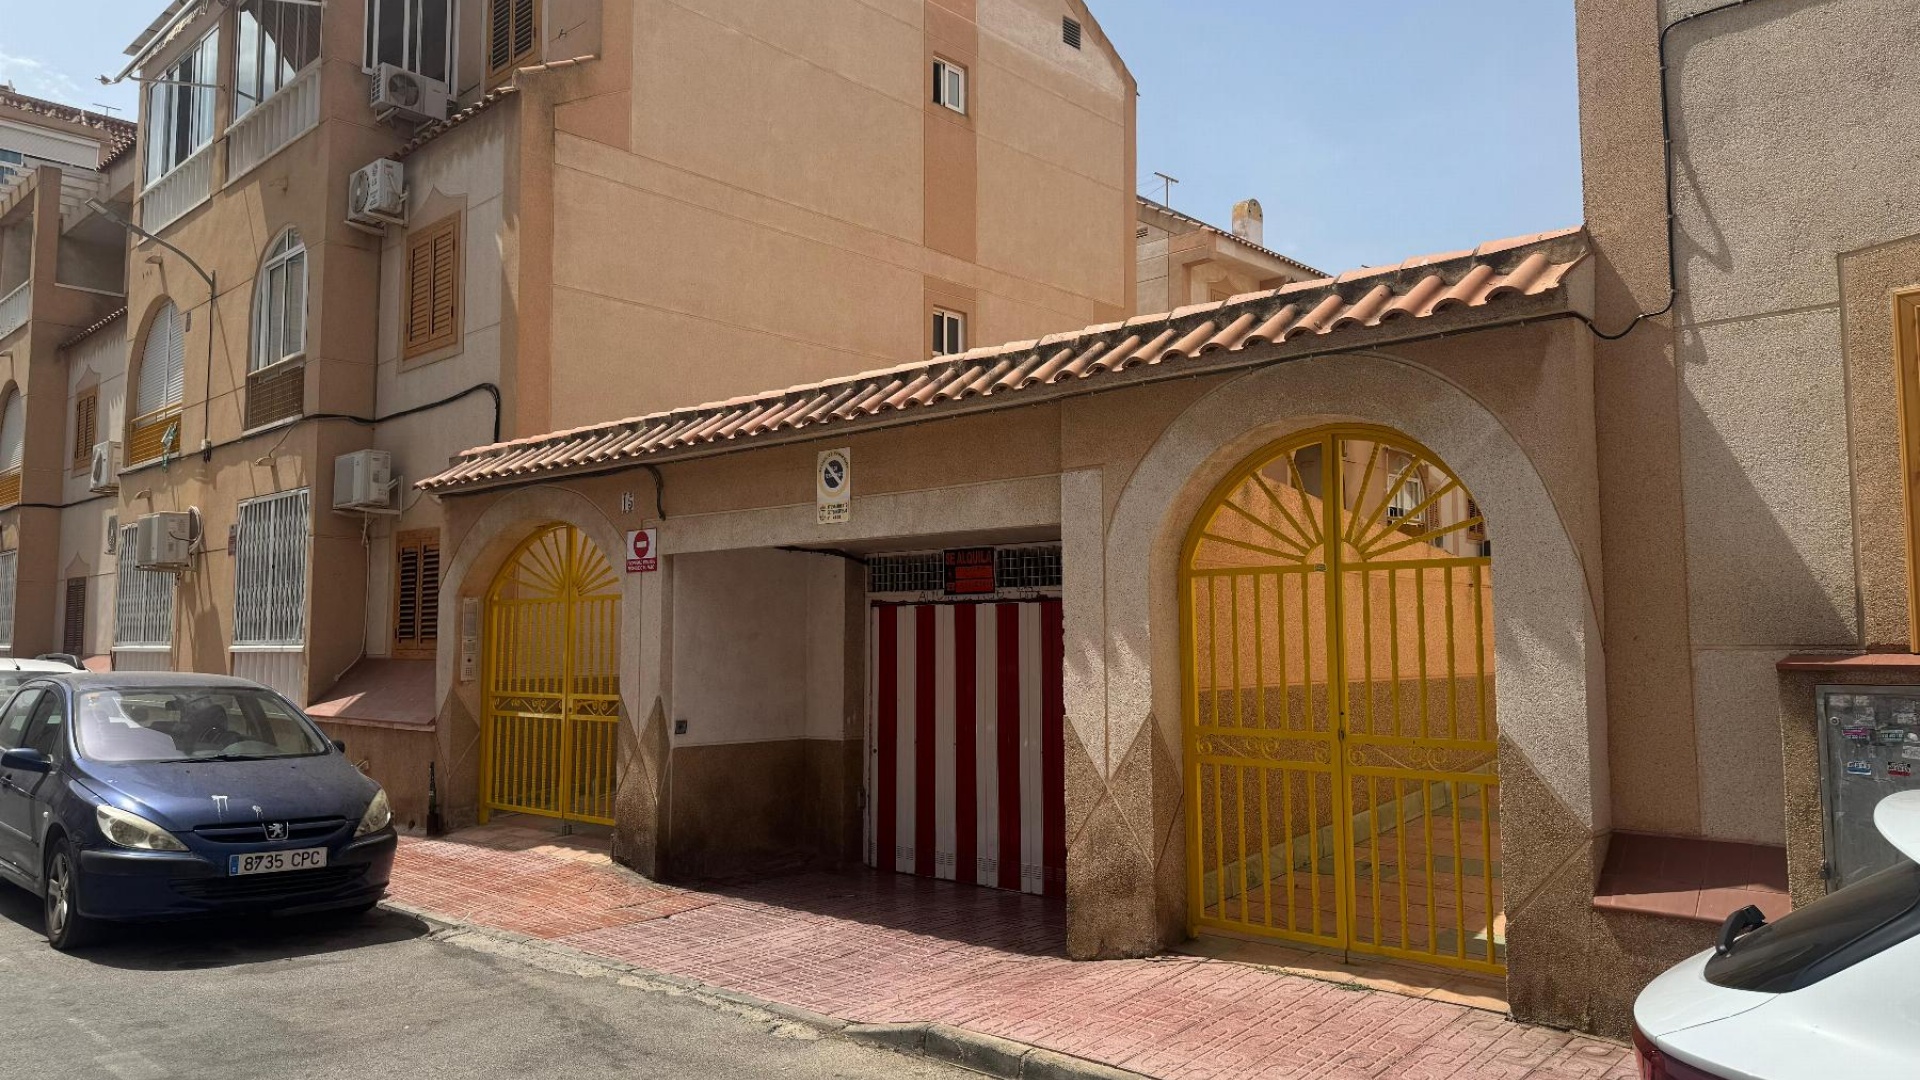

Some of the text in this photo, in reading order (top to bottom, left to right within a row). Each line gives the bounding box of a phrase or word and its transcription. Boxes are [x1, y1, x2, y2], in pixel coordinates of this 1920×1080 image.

[623, 492, 634, 511] 15
[945, 549, 992, 566] SE ALQUILA
[243, 851, 320, 872] 8735 CPC
